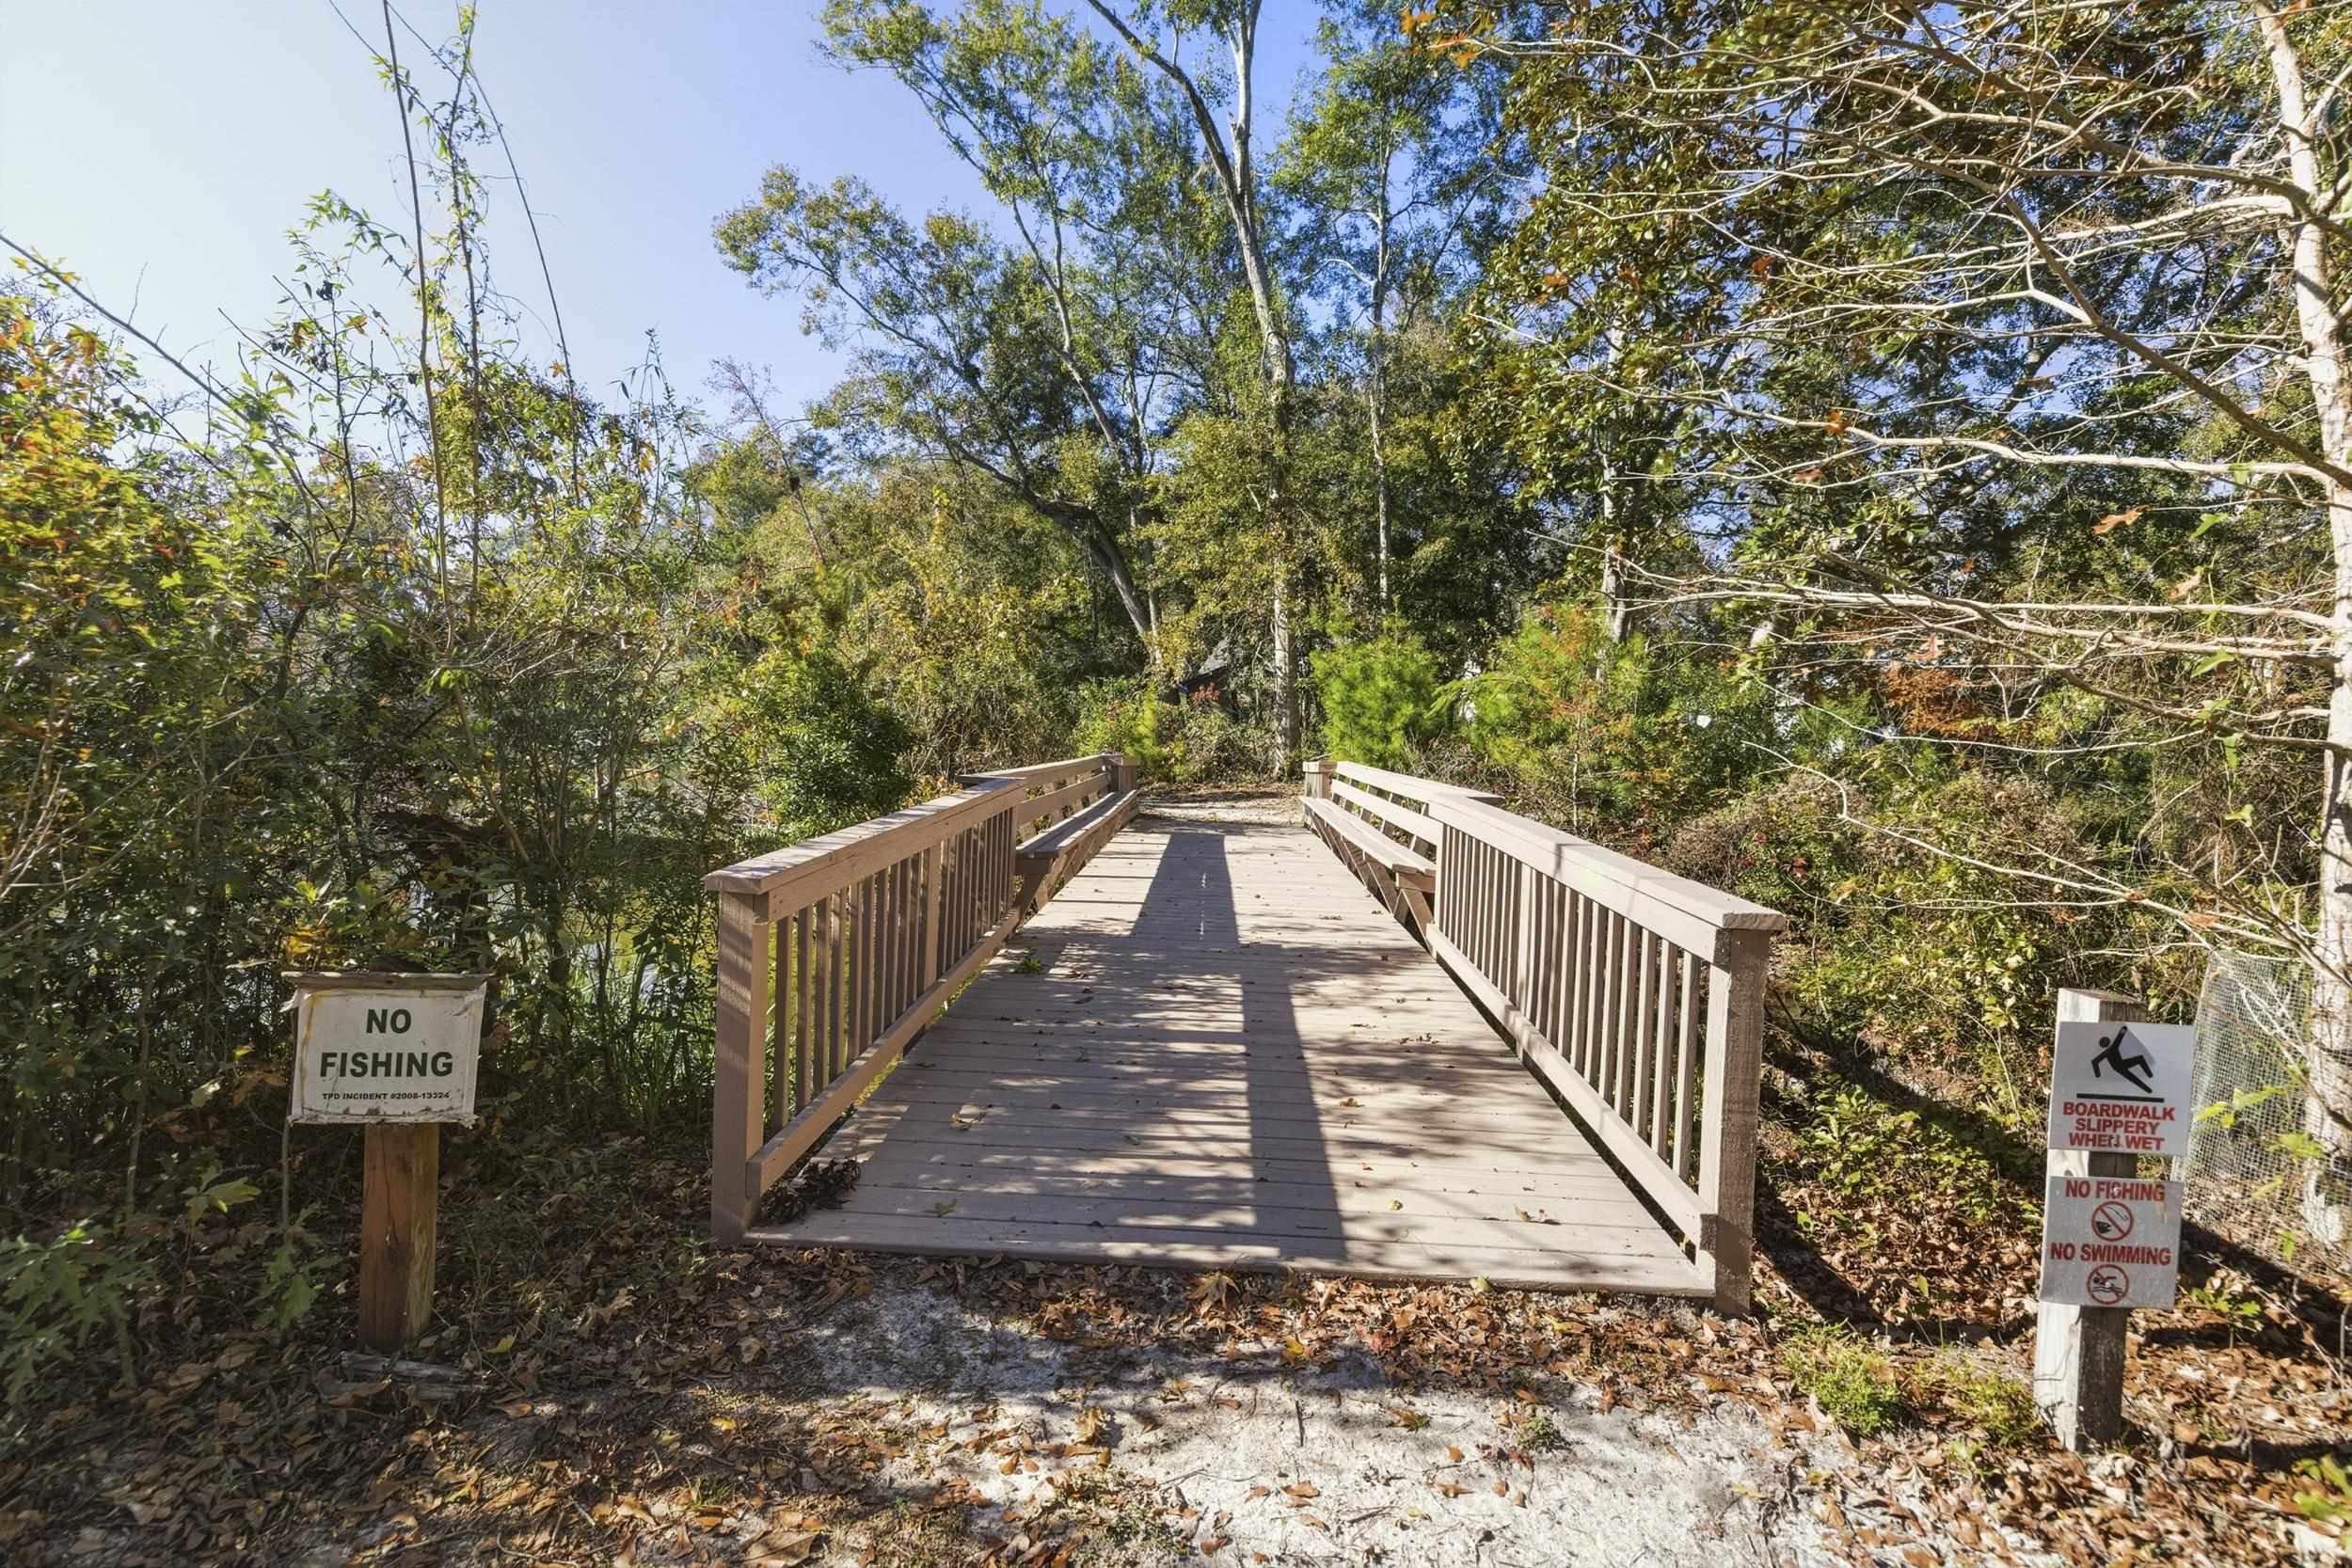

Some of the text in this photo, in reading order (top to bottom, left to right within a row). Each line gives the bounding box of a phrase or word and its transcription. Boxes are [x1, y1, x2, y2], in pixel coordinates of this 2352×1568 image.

[366, 1008, 411, 1034] NO
[319, 1051, 453, 1077] FISHING
[2062, 1101, 2176, 1121] BOARDWALK
[2074, 1117, 2161, 1135] SLIPPERY
[2124, 1135, 2165, 1150] WET
[2065, 1180, 2167, 1202] NO FISHING
[2050, 1243, 2171, 1266] NO SWIMMING
